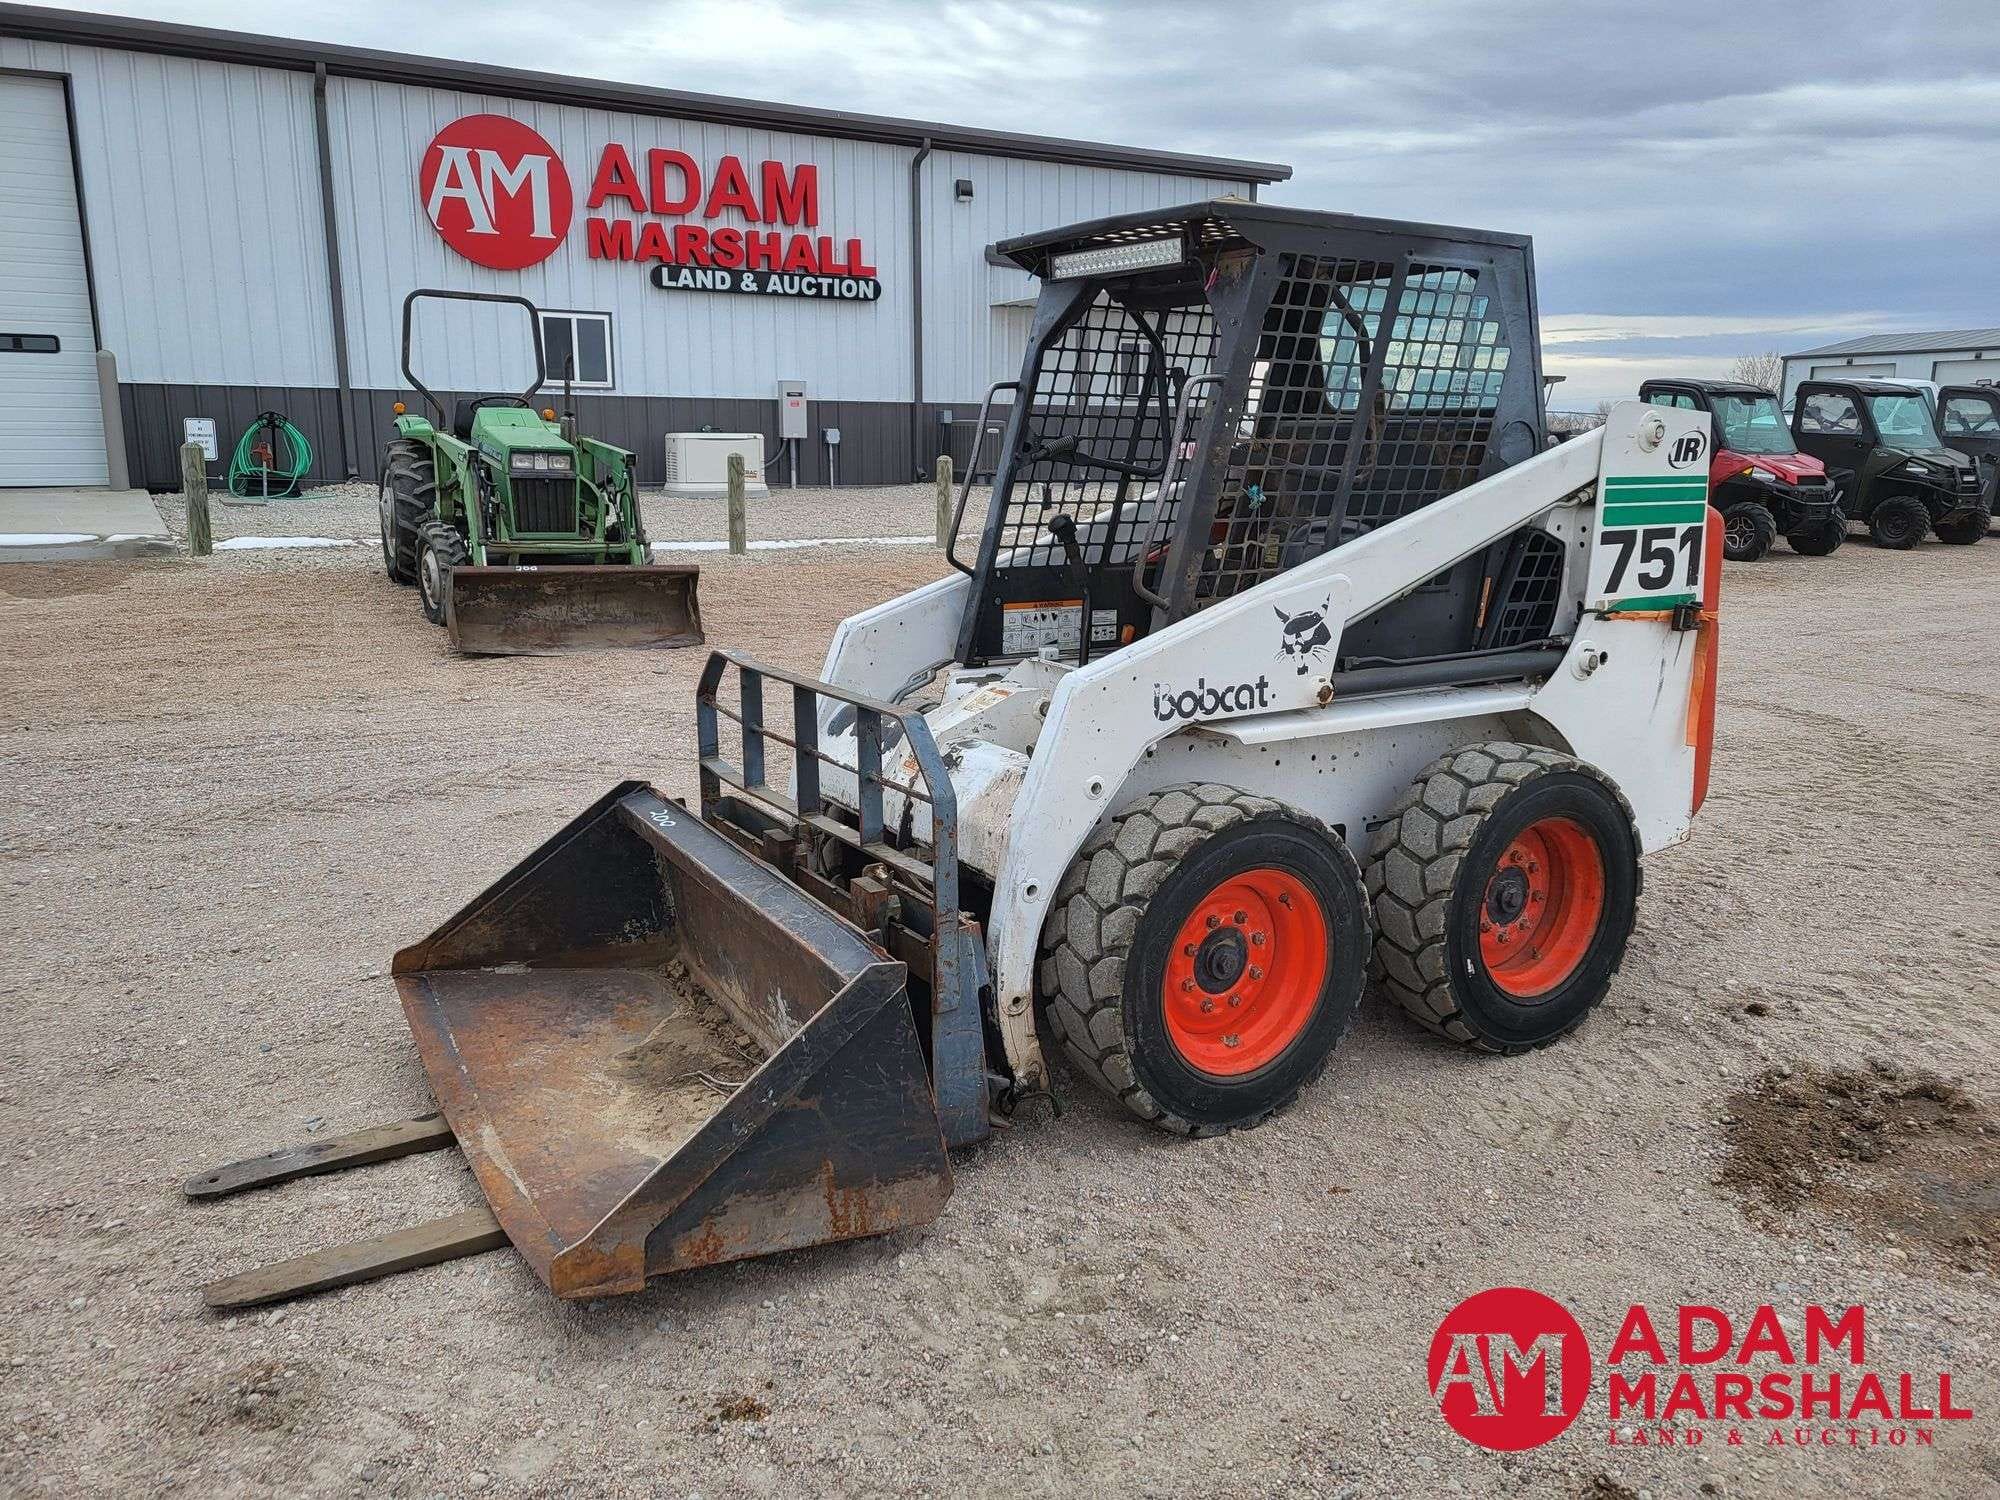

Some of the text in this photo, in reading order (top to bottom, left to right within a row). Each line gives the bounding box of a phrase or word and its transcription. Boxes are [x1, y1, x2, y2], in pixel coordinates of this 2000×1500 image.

[426, 145, 556, 239] AM
[586, 142, 818, 227] ADAM
[586, 217, 877, 277] MARSHALL
[660, 266, 875, 299] LAND & AUCTION
[1673, 437, 1701, 462] IR
[1600, 526, 1704, 594] 751
